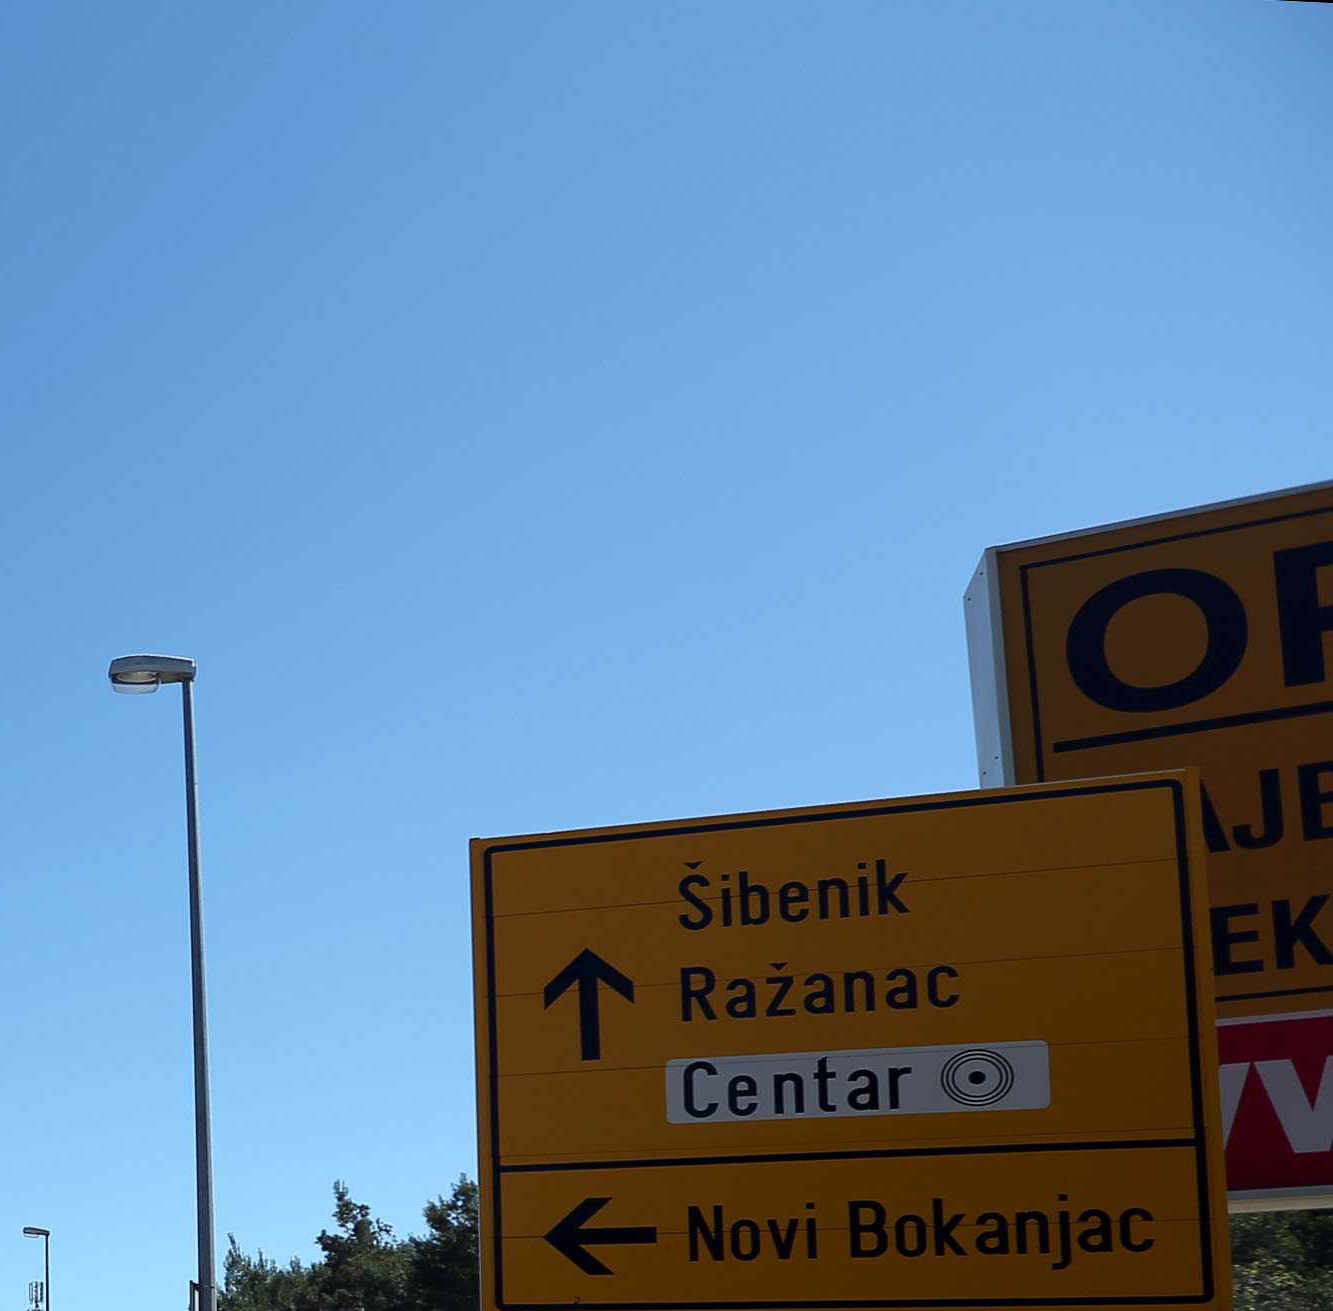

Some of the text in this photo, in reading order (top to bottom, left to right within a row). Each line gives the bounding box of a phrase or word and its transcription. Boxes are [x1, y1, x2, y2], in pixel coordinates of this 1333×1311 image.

[677, 857, 911, 932] Šibenik
[679, 961, 961, 1023] Ražanac
[682, 1056, 913, 1119] Centar
[686, 1194, 1156, 1271] Novi Bokanjac
